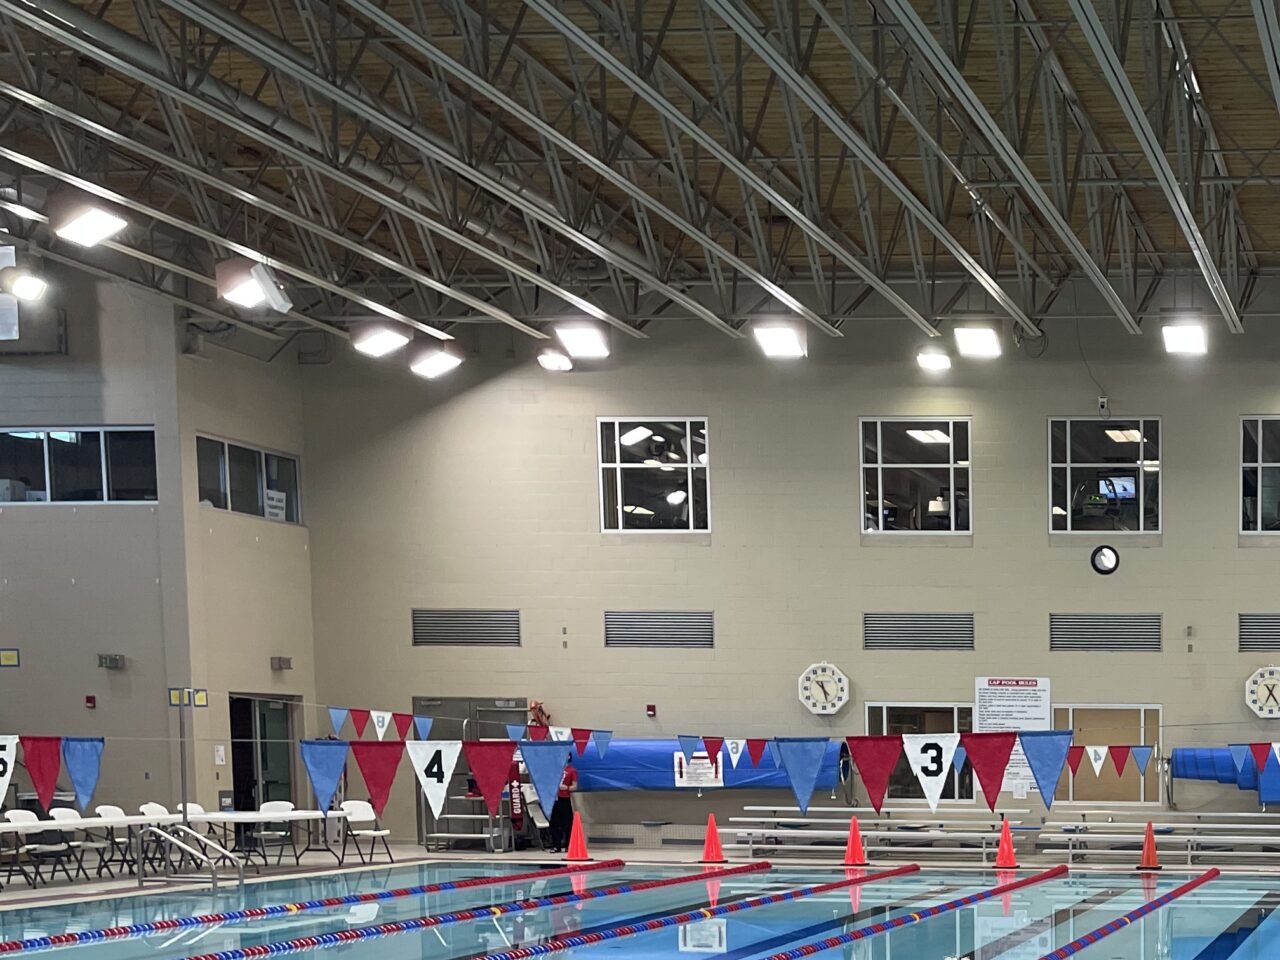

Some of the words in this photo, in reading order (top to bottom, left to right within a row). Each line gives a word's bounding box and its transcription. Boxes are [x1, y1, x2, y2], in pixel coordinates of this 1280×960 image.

[424, 749, 445, 783] 4
[920, 742, 943, 777] 3
[512, 788, 521, 814] GUARD
